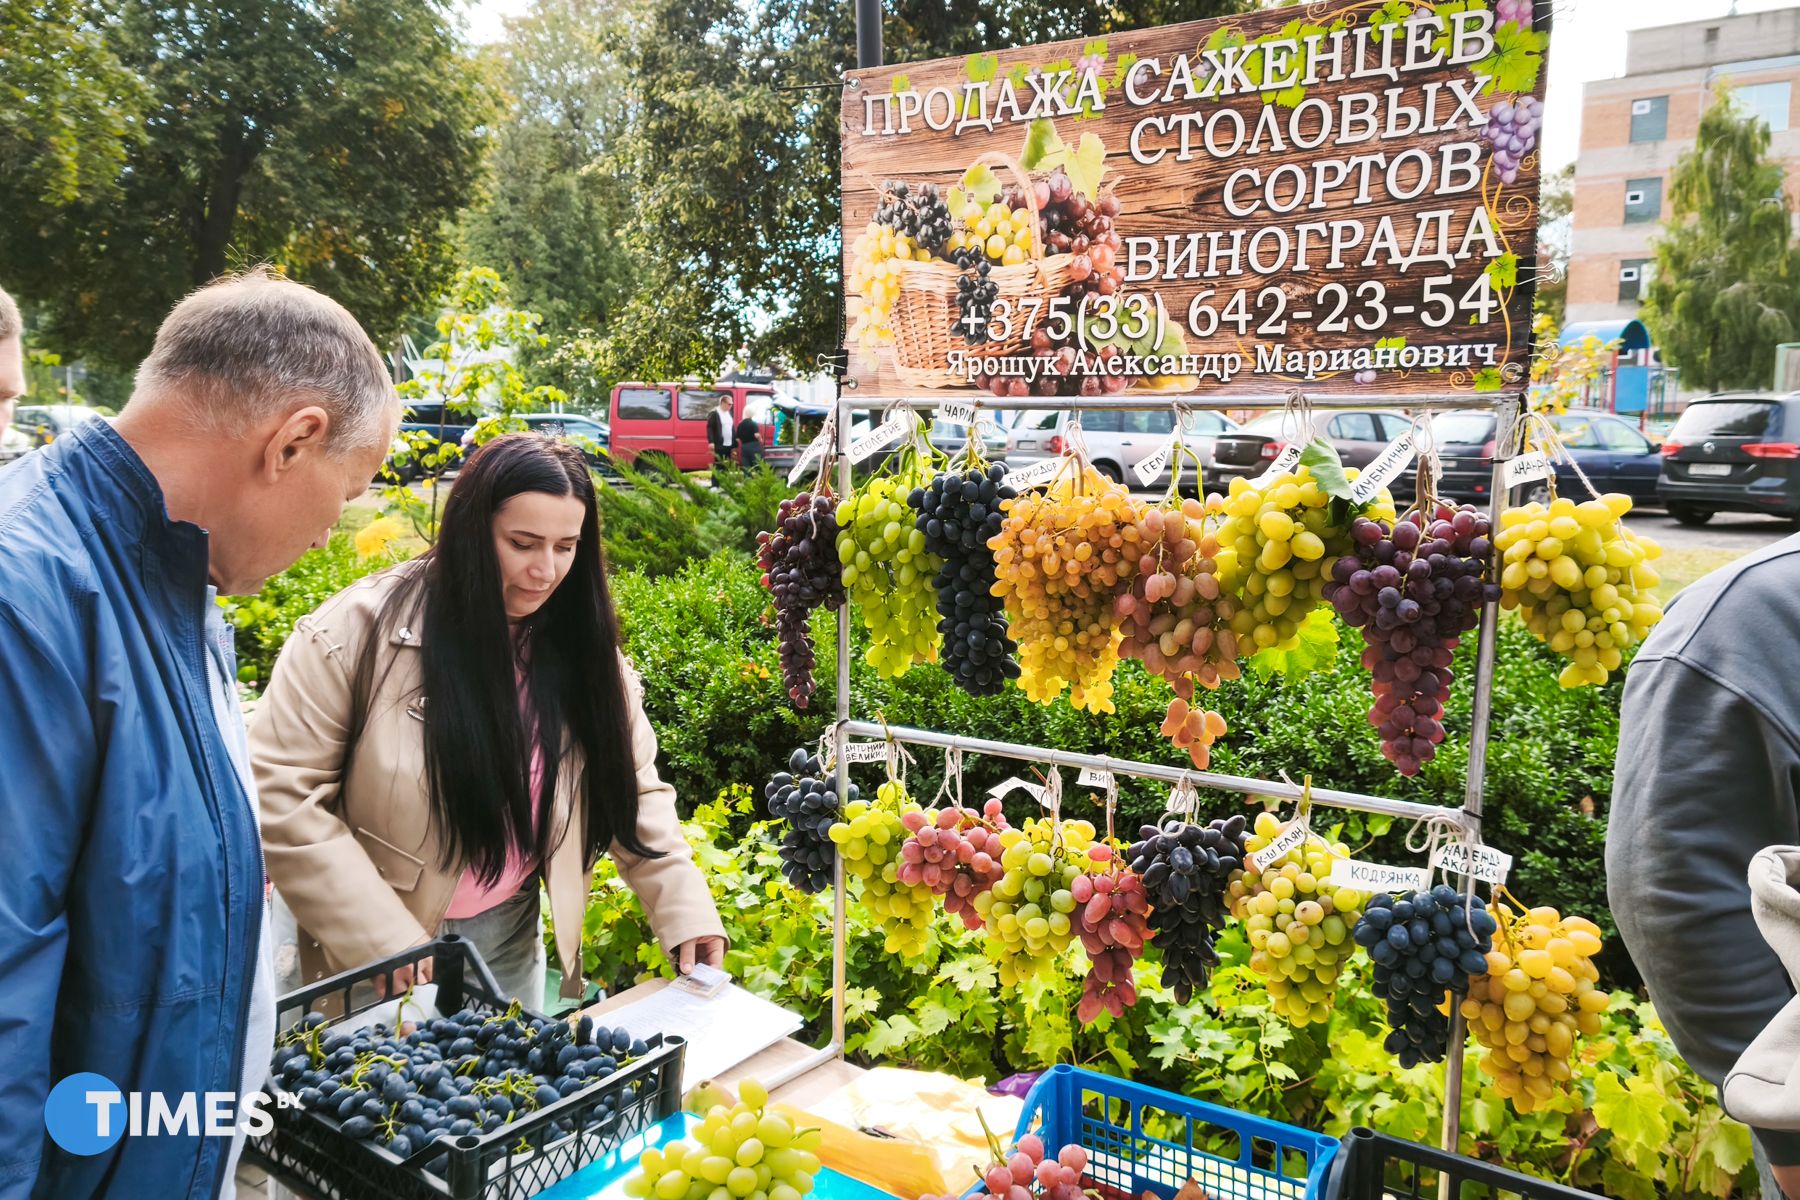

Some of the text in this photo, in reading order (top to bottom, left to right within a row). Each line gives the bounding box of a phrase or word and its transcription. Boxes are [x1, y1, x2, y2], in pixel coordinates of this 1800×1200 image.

[861, 8, 1495, 137] ПРОДАЖА САЖЕНЦЕВ
[1129, 74, 1493, 165] СТОЛОВЫХ
[1222, 142, 1482, 218] СОРТОВ
[1123, 205, 1502, 282] ВИНОГРАДА
[960, 272, 1499, 352] +375(33) 642-23-54
[945, 342, 1498, 382] Ярошук Александр Марианович
[852, 421, 902, 458] СТОЛЕТИЕ
[944, 403, 975, 423] ЧАРЛИ
[1350, 864, 1422, 887] КОДРЯНКА
